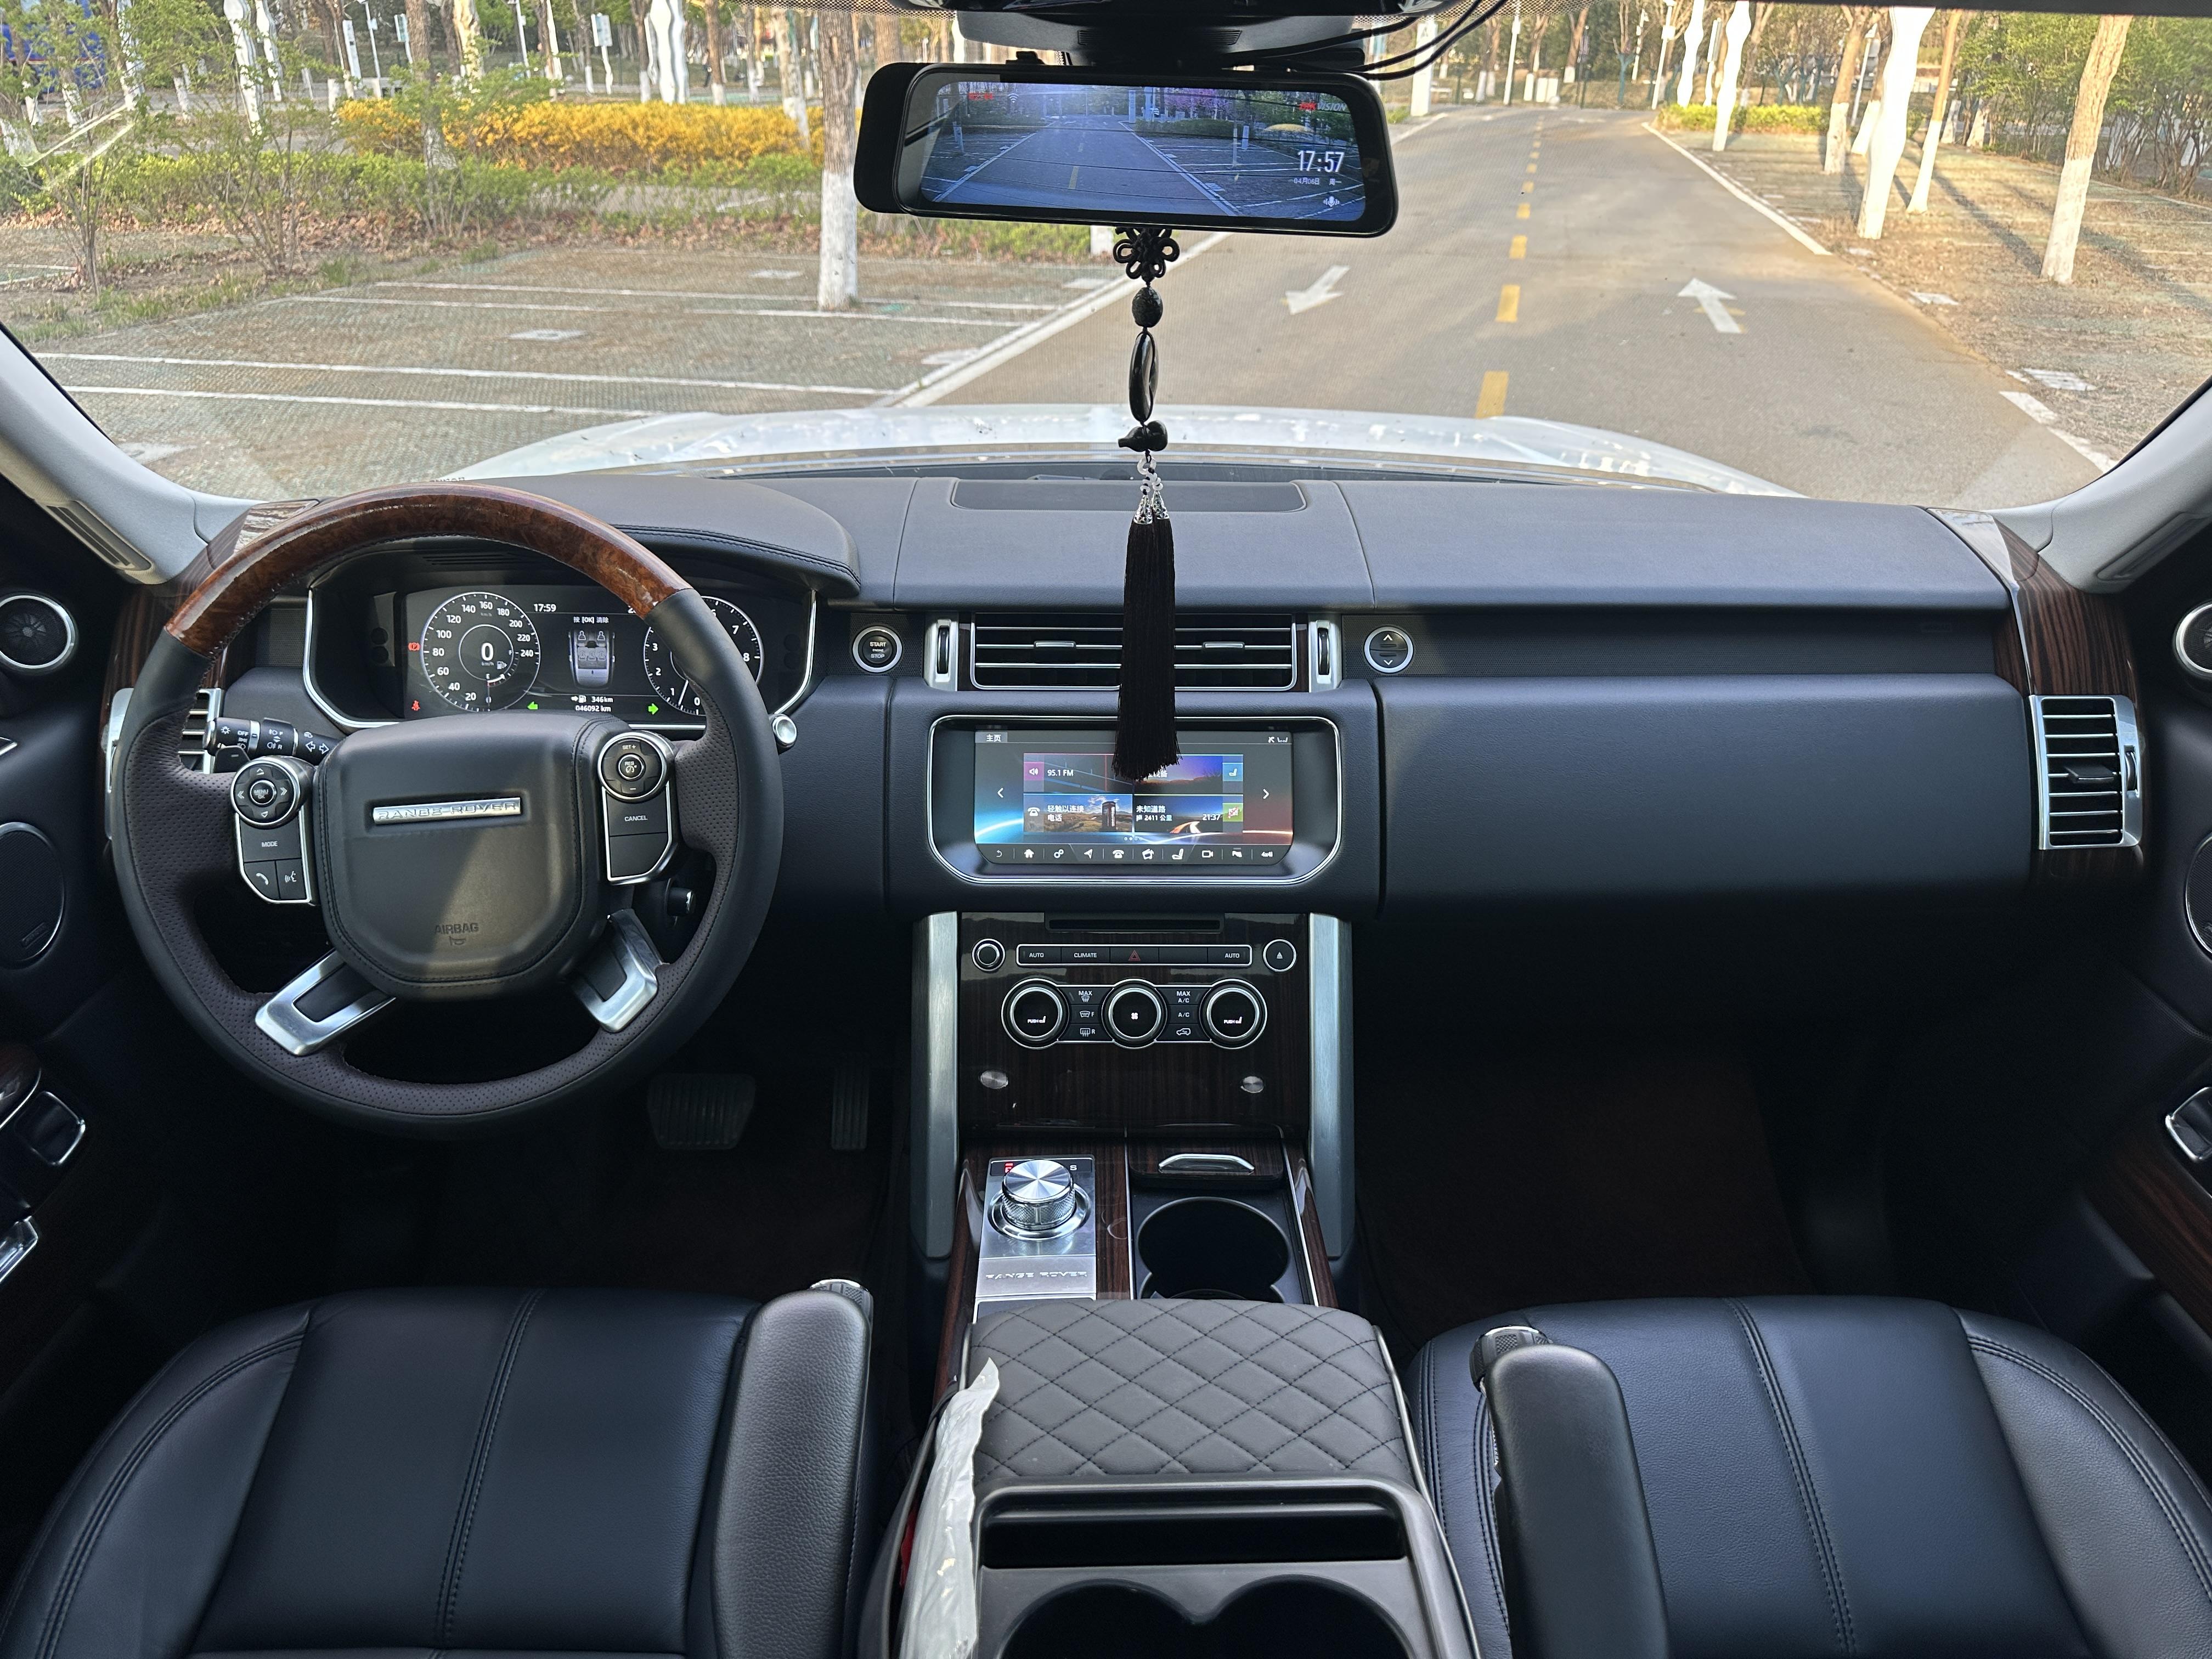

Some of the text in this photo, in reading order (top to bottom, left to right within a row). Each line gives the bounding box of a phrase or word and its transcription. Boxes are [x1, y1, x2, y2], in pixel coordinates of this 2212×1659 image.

[1298, 150, 1345, 172] 17:57
[461, 605, 476, 613] 140
[478, 601, 493, 610] 160
[534, 603, 557, 612] 17:59
[496, 608, 510, 616] 180
[447, 614, 461, 624] 120
[509, 619, 523, 628] 200
[732, 625, 739, 634] 7
[437, 630, 452, 639] 100
[517, 634, 531, 642] 220
[652, 642, 658, 651] 3
[432, 647, 445, 656] 80
[481, 642, 494, 661] 0
[521, 649, 534, 657] 240
[743, 652, 750, 662] 8
[437, 667, 449, 675] 60
[656, 667, 661, 676] 2
[448, 682, 460, 691] 40
[670, 687, 675, 696] 1
[465, 692, 477, 701] 20
[694, 697, 701, 706] 0
[986, 734, 1001, 742] 主页
[450, 801, 517, 815] ROVER
[1136, 805, 1166, 813] 未知道路
[1047, 814, 1063, 822] 电话
[435, 922, 479, 935] AIRBAG
